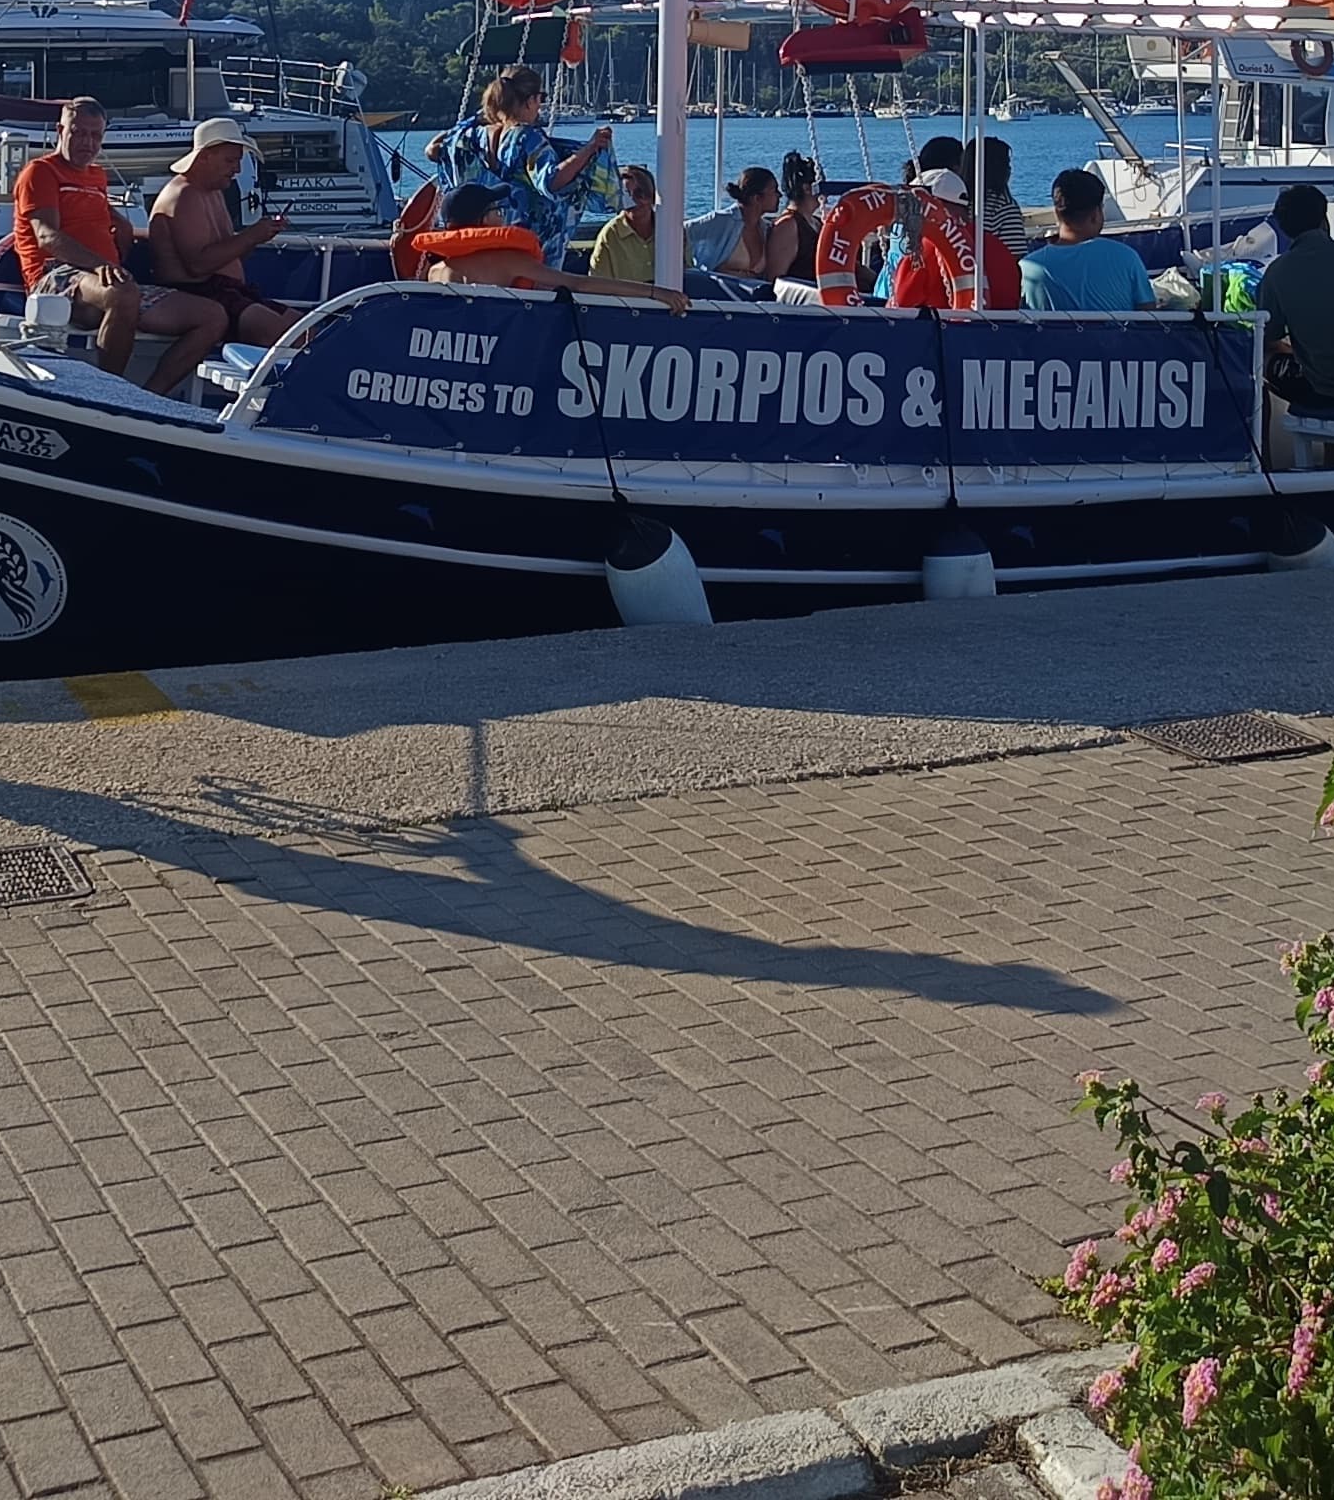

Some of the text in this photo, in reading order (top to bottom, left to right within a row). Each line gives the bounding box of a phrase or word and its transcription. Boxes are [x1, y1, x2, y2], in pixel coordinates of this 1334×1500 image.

[294, 203, 338, 211] LONDON
[409, 327, 499, 365] DAILY
[347, 368, 534, 417] CRUISES TO
[557, 340, 1206, 430] SKORPIOS & MEGANISI
[20, 443, 53, 457] 262
